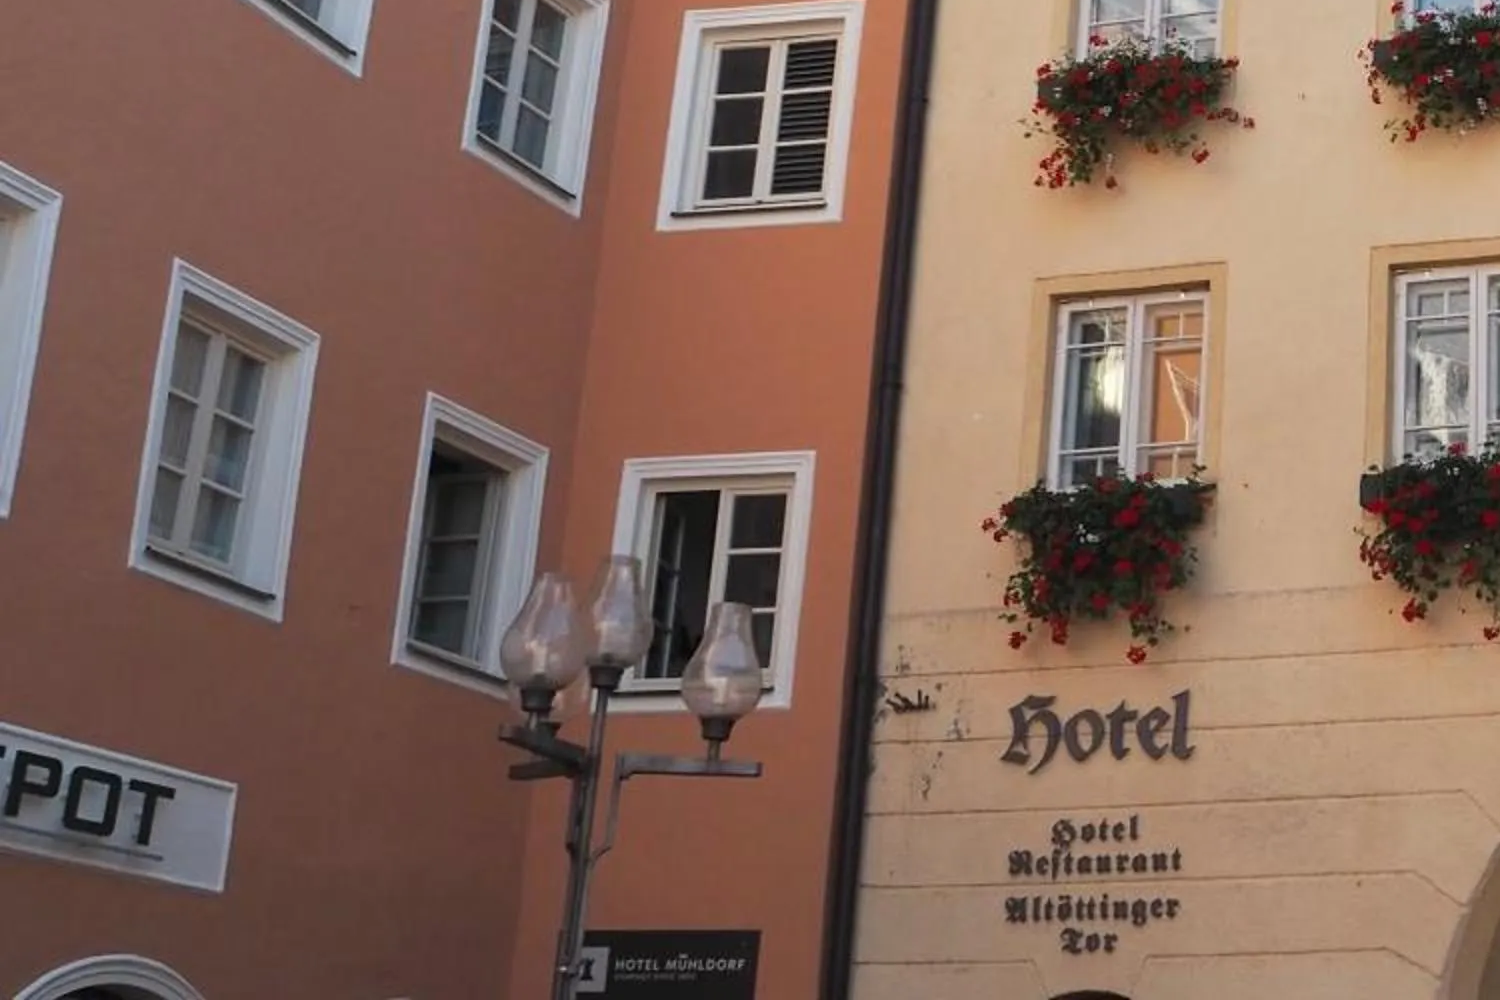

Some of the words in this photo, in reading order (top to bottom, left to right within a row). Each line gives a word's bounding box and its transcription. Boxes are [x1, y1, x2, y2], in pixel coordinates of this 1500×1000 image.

[1000, 688, 1196, 775] Hotel
[0, 745, 176, 846] POT
[1051, 815, 1140, 849] Hotel
[1004, 894, 1181, 927] Altöttinger
[1060, 927, 1119, 955] Tor
[614, 959, 658, 971] HOTEL
[665, 953, 747, 972] MÜHLDORF
